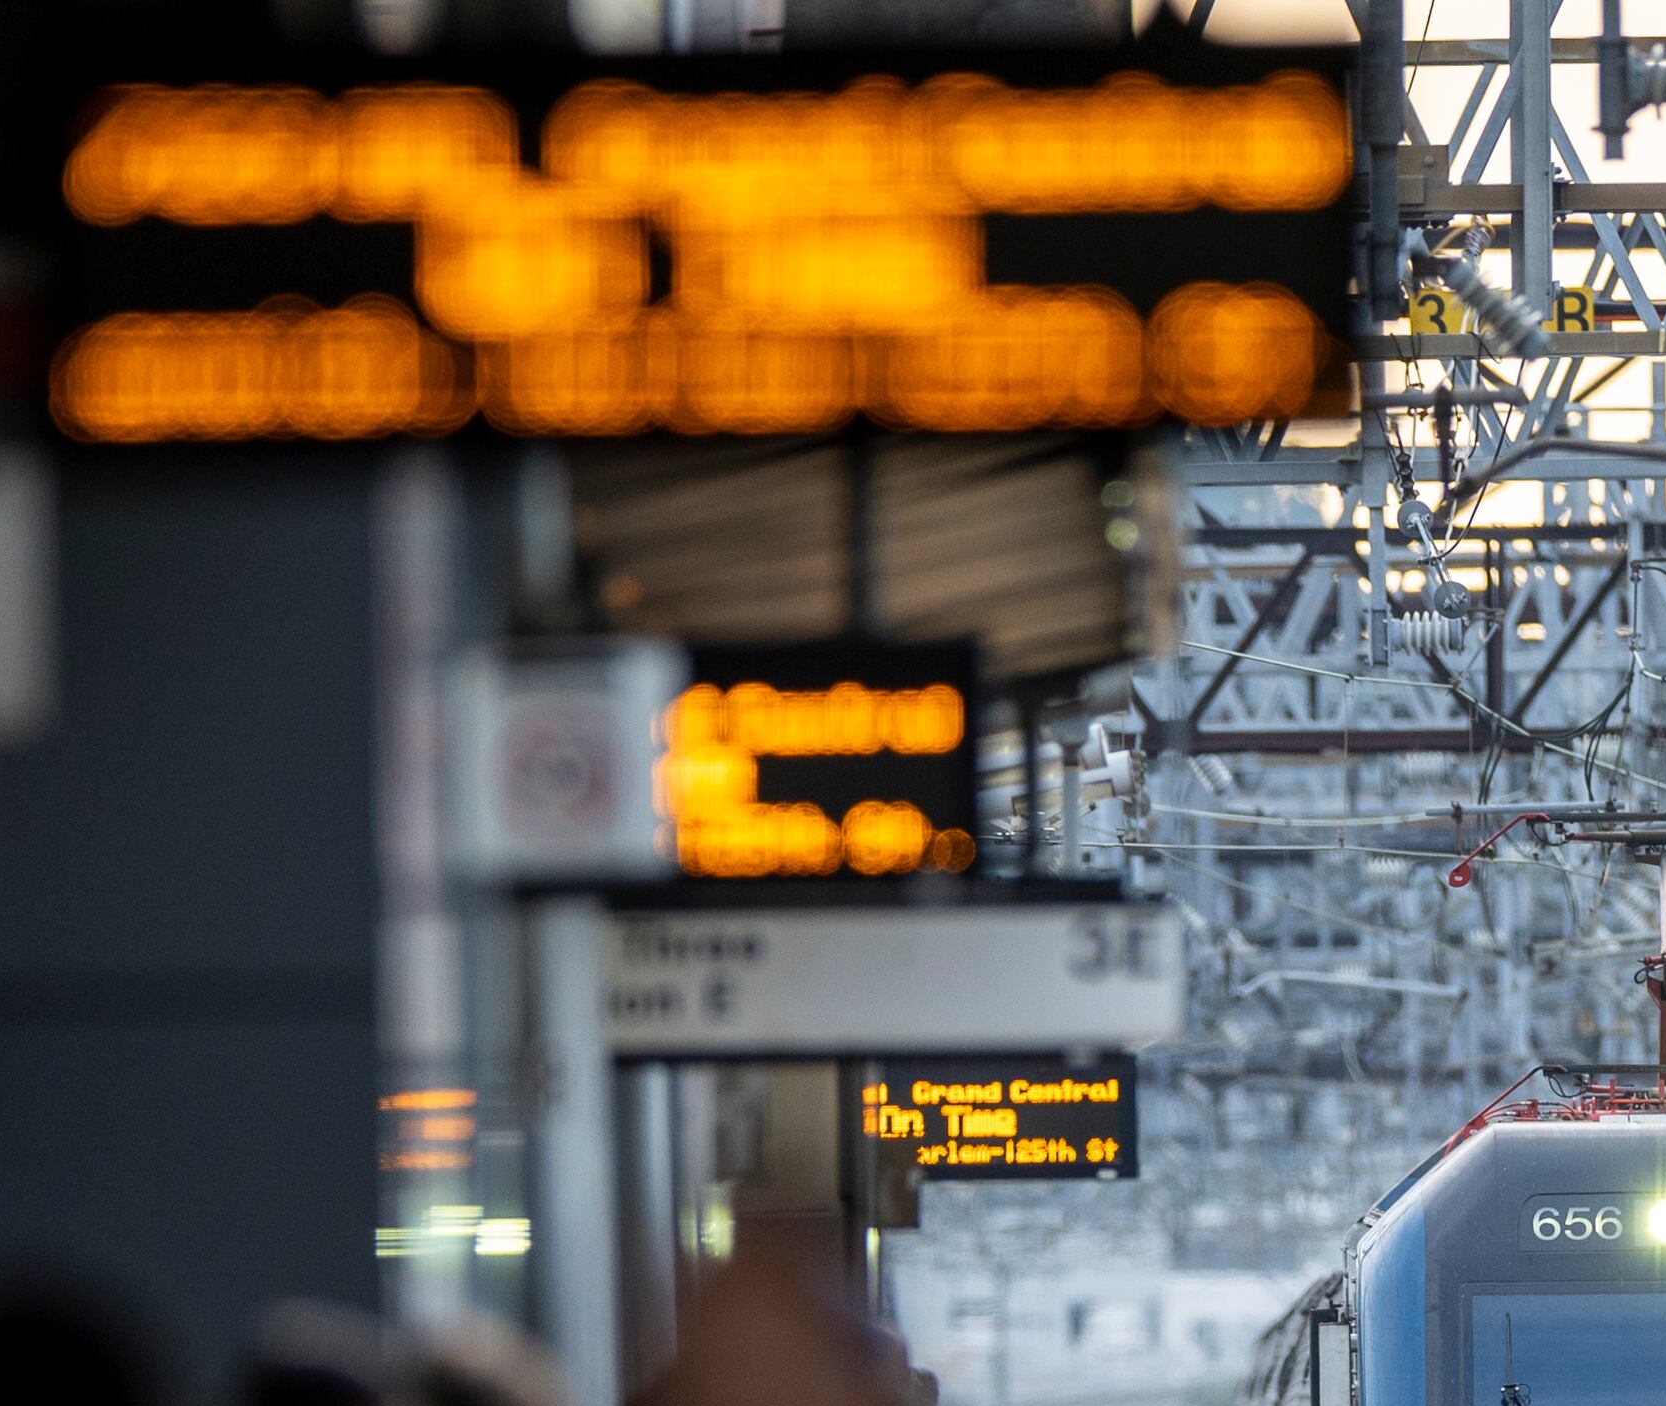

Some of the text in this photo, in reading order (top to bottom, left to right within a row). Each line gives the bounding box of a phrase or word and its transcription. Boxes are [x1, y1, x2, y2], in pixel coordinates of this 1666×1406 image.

[912, 1080, 1003, 1105] Grand
[1009, 1078, 1119, 1104] Central
[940, 1104, 1018, 1138] Time
[1532, 1206, 1623, 1241] 656
